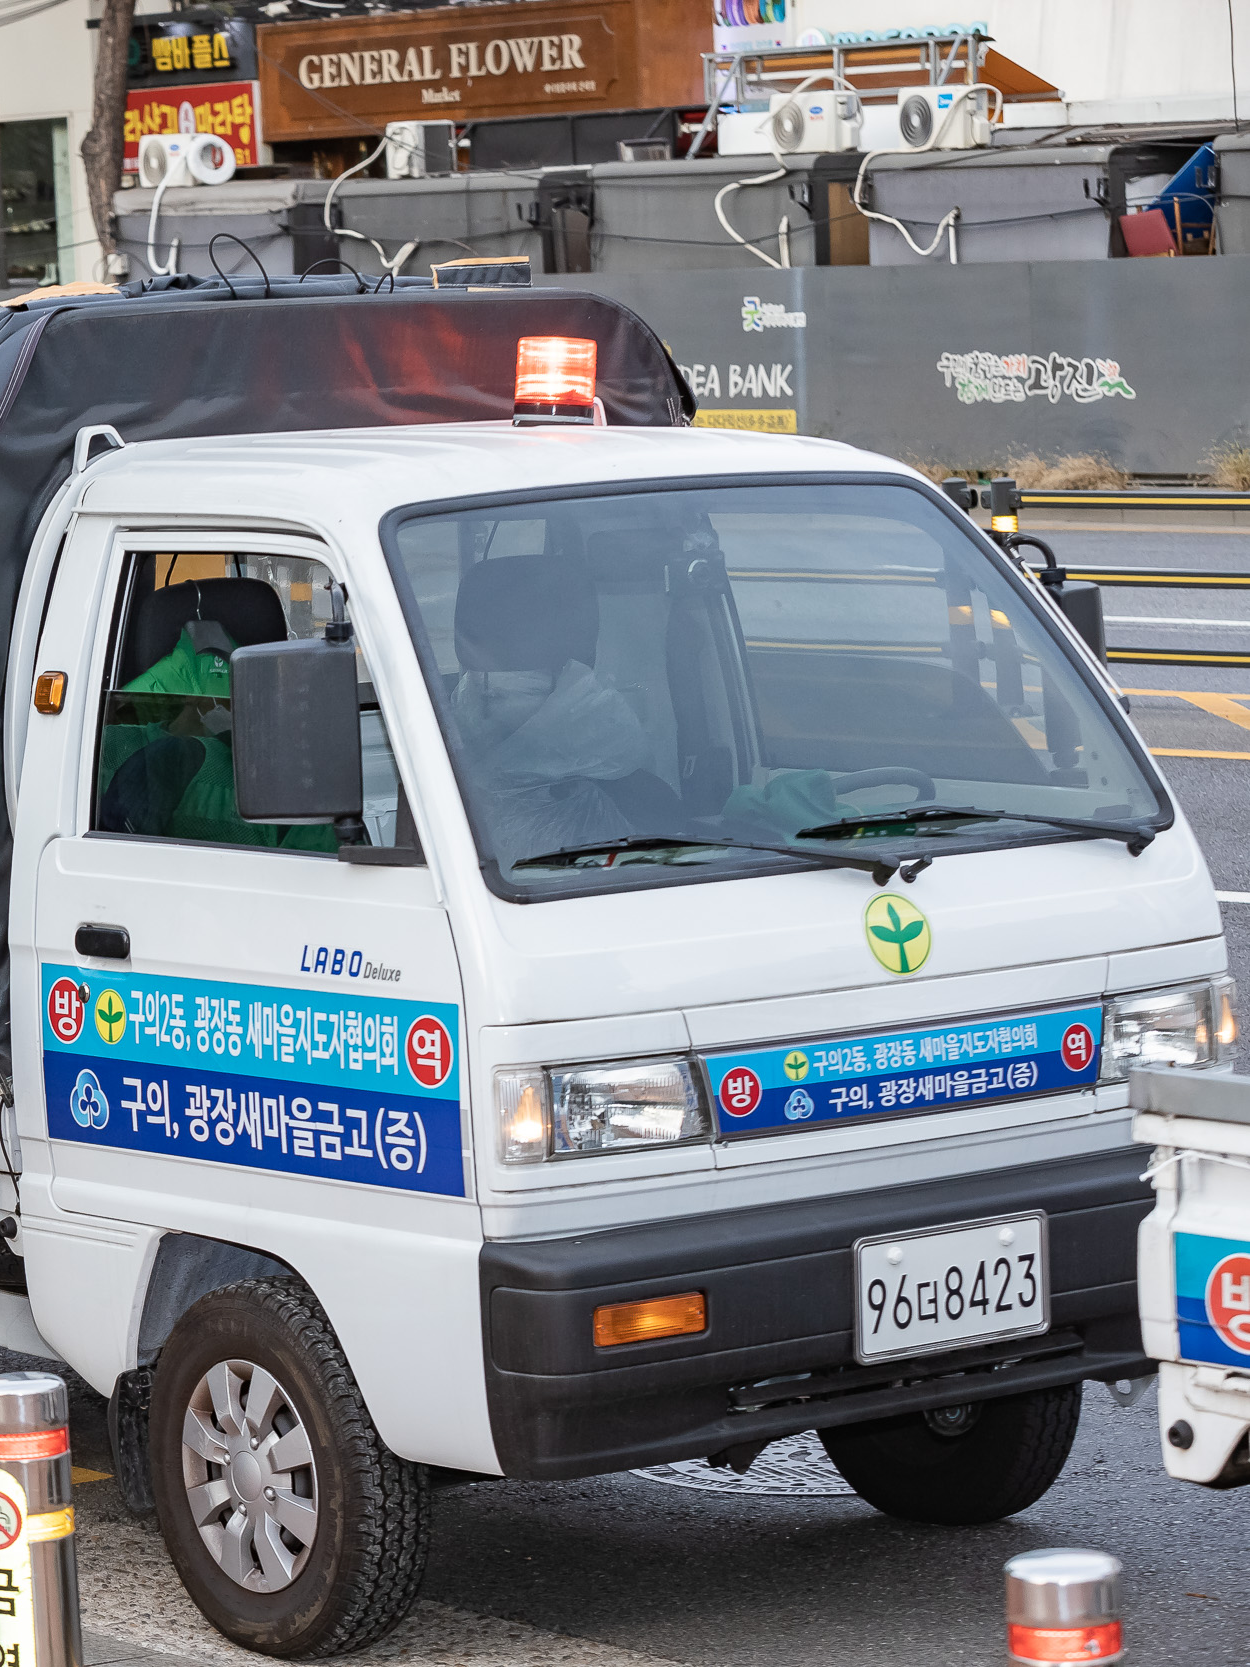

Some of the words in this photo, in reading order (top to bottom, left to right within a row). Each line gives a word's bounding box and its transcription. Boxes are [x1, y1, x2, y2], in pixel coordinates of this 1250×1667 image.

[299, 46, 442, 89] GENERAL
[449, 34, 586, 78] FLOWER
[422, 86, 461, 104] Market
[729, 363, 794, 398] BANK
[1026, 352, 1102, 403] 광진
[300, 944, 363, 978] LABO
[363, 961, 402, 982] Deluxe
[54, 990, 82, 1036] 방
[128, 990, 191, 1051] 구의2동,
[194, 996, 243, 1057] 광장동
[245, 1001, 399, 1076] 새마을지도자협의회
[411, 1026, 444, 1081] 역
[812, 1046, 872, 1077] 구의2동,
[873, 1039, 917, 1070] 광장동
[919, 1022, 1038, 1064] 새마을지도자협의회
[1066, 1031, 1088, 1062] 역
[727, 1075, 754, 1109] 방
[828, 1083, 875, 1114] 구의,
[877, 1060, 1039, 1106] 광장새마을금고(증)
[121, 1076, 180, 1139] 구의,
[184, 1084, 428, 1174] 광장새마을금고(증)
[867, 1252, 1037, 1335] 96더8423
